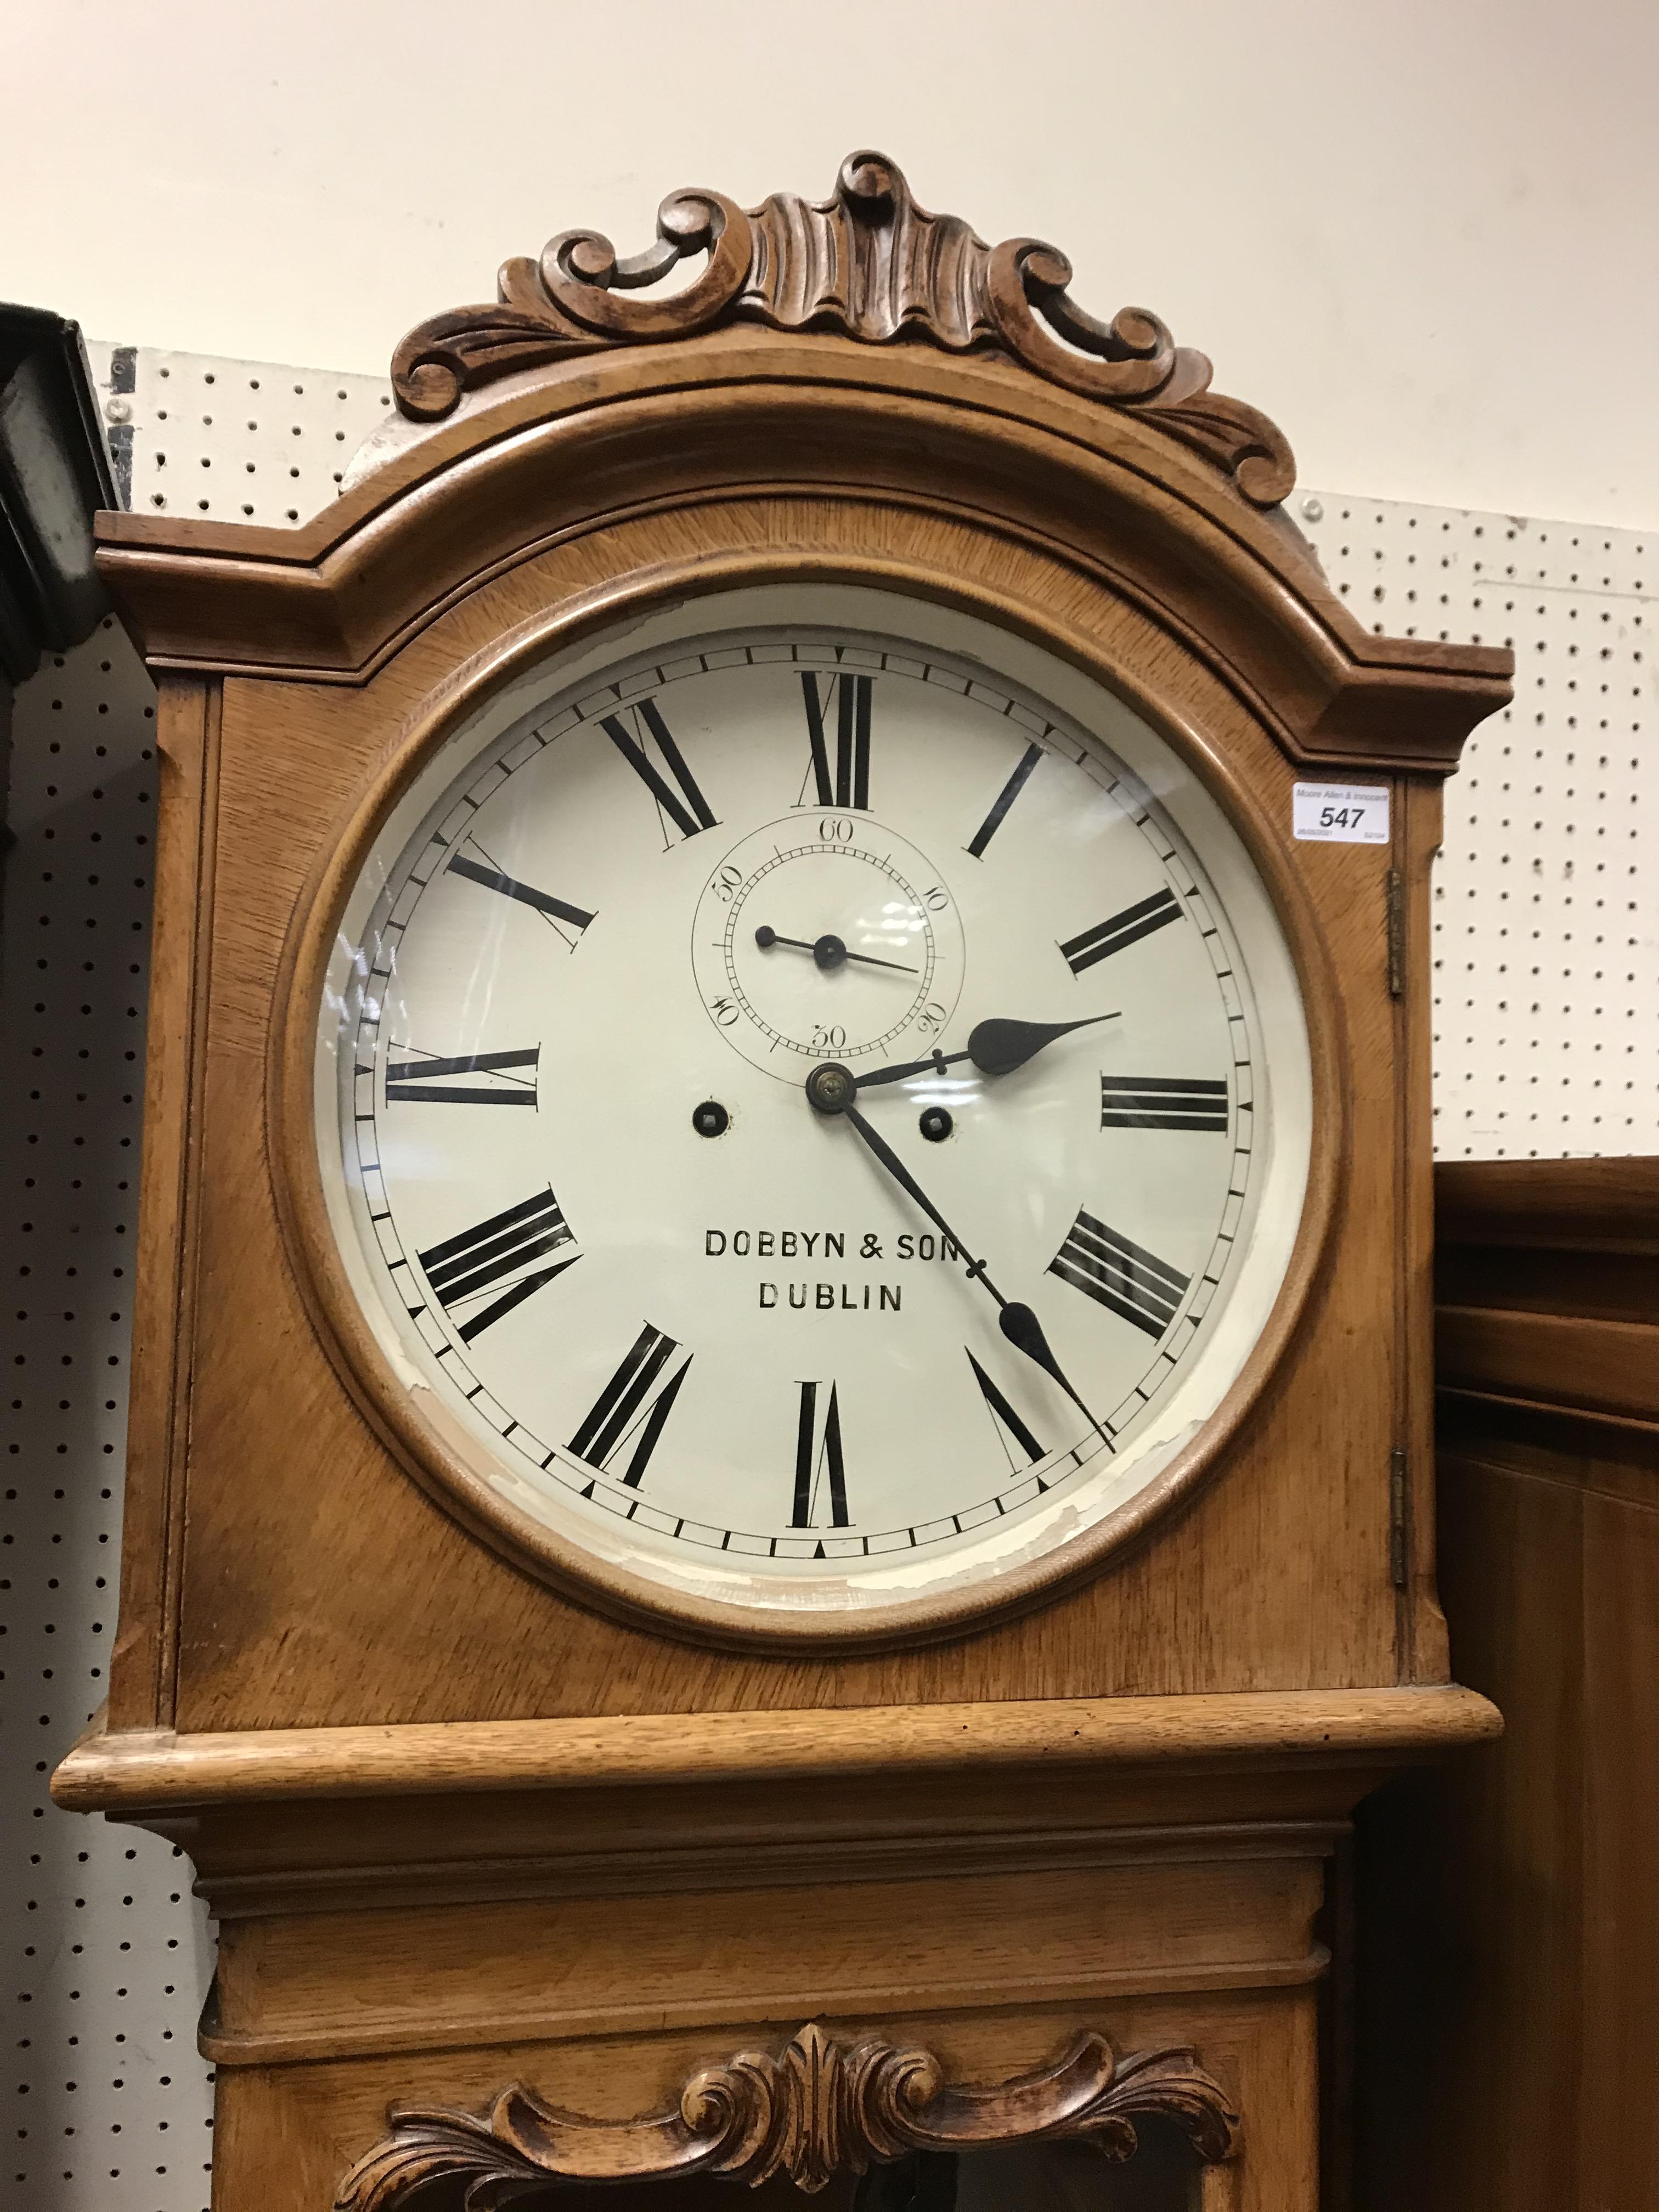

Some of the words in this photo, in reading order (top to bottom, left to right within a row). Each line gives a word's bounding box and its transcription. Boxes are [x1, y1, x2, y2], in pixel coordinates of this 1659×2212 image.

[594, 695, 723, 852] XI
[791, 670, 878, 812] XII
[819, 817, 854, 842] 60
[961, 737, 1051, 862] I
[1319, 807, 1365, 828] 547
[443, 831, 599, 954] X
[711, 866, 743, 902] 50
[922, 883, 949, 911] 10
[1054, 880, 1188, 980] II
[709, 996, 740, 1026] 40
[811, 1024, 846, 1048] 30
[917, 1003, 947, 1035] 20
[386, 1036, 540, 1112] IX
[1099, 1070, 1228, 1138] III
[416, 1181, 584, 1350] VIII
[706, 1230, 845, 1258] DOBBYN
[860, 1233, 884, 1259] &
[896, 1234, 959, 1261] SON
[1044, 1203, 1194, 1346] IIII
[759, 1282, 901, 1311] DUBLIN
[561, 1319, 693, 1492] VII
[964, 1345, 1053, 1477] V
[786, 1379, 856, 1528] VI
